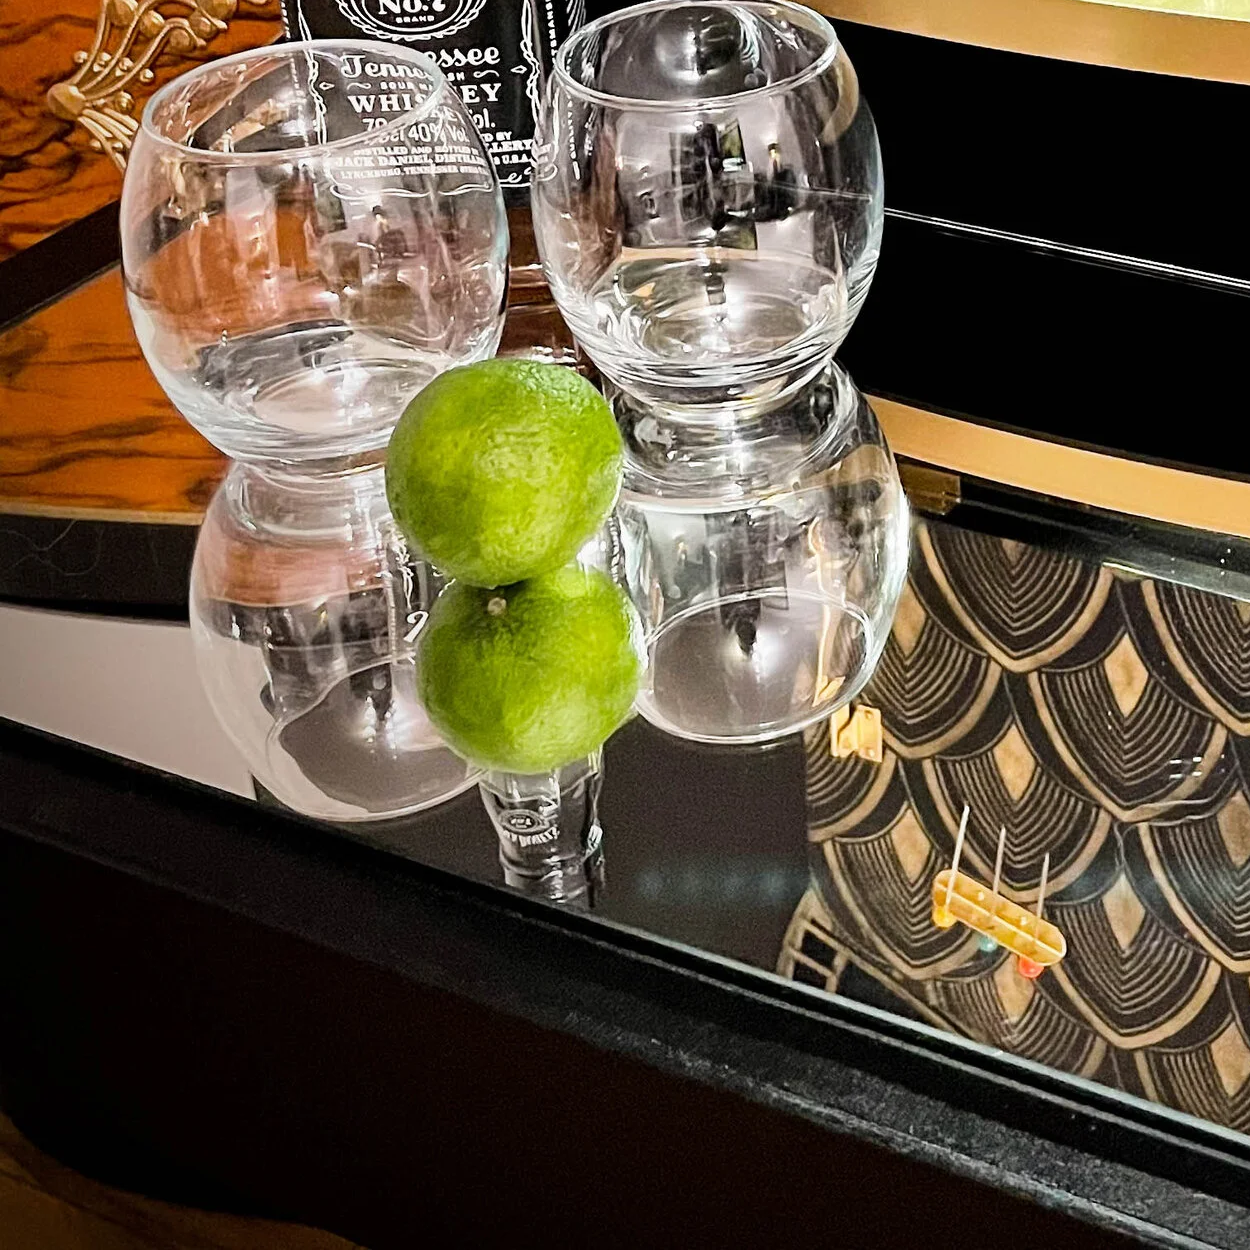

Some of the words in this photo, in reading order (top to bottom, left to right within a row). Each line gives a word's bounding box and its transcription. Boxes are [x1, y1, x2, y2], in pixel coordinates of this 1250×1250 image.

[395, 15, 435, 24] BRAND
[380, 81, 413, 90] SOUR
[347, 83, 502, 114] WHISEY
[411, 146, 432, 155] AND
